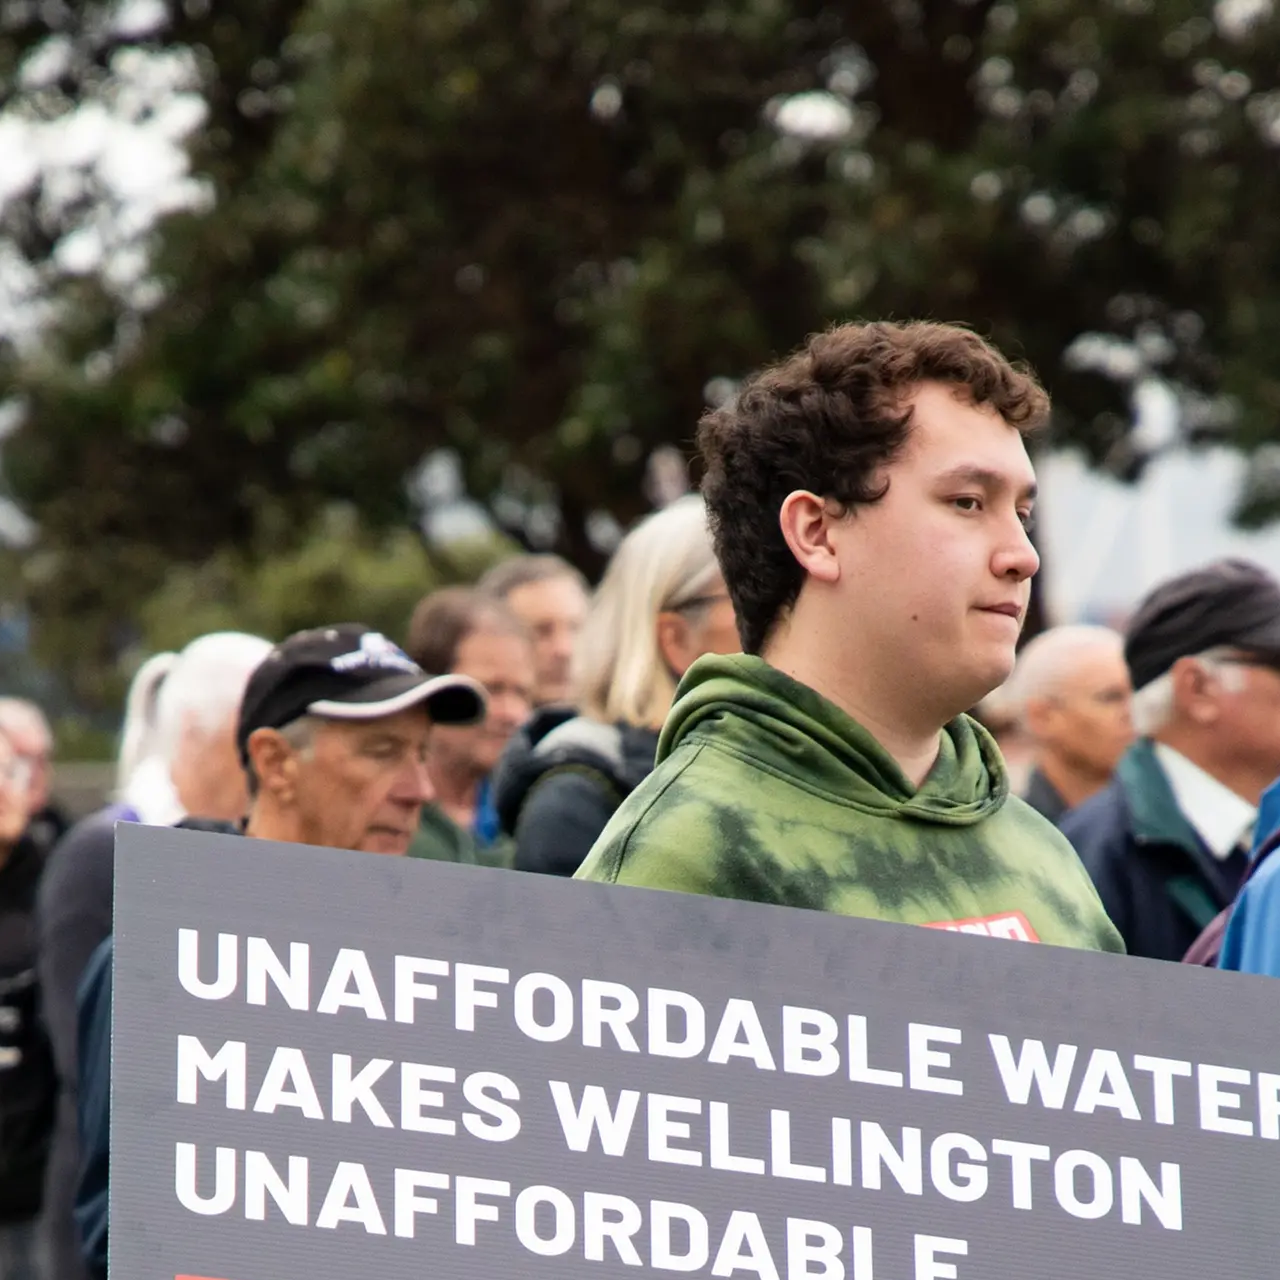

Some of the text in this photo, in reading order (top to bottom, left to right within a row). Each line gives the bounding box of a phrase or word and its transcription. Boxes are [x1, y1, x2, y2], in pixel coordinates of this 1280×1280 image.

[178, 928, 964, 1096] UNAFFORDABLE
[176, 1034, 1183, 1231] MAKES WELLINGTON
